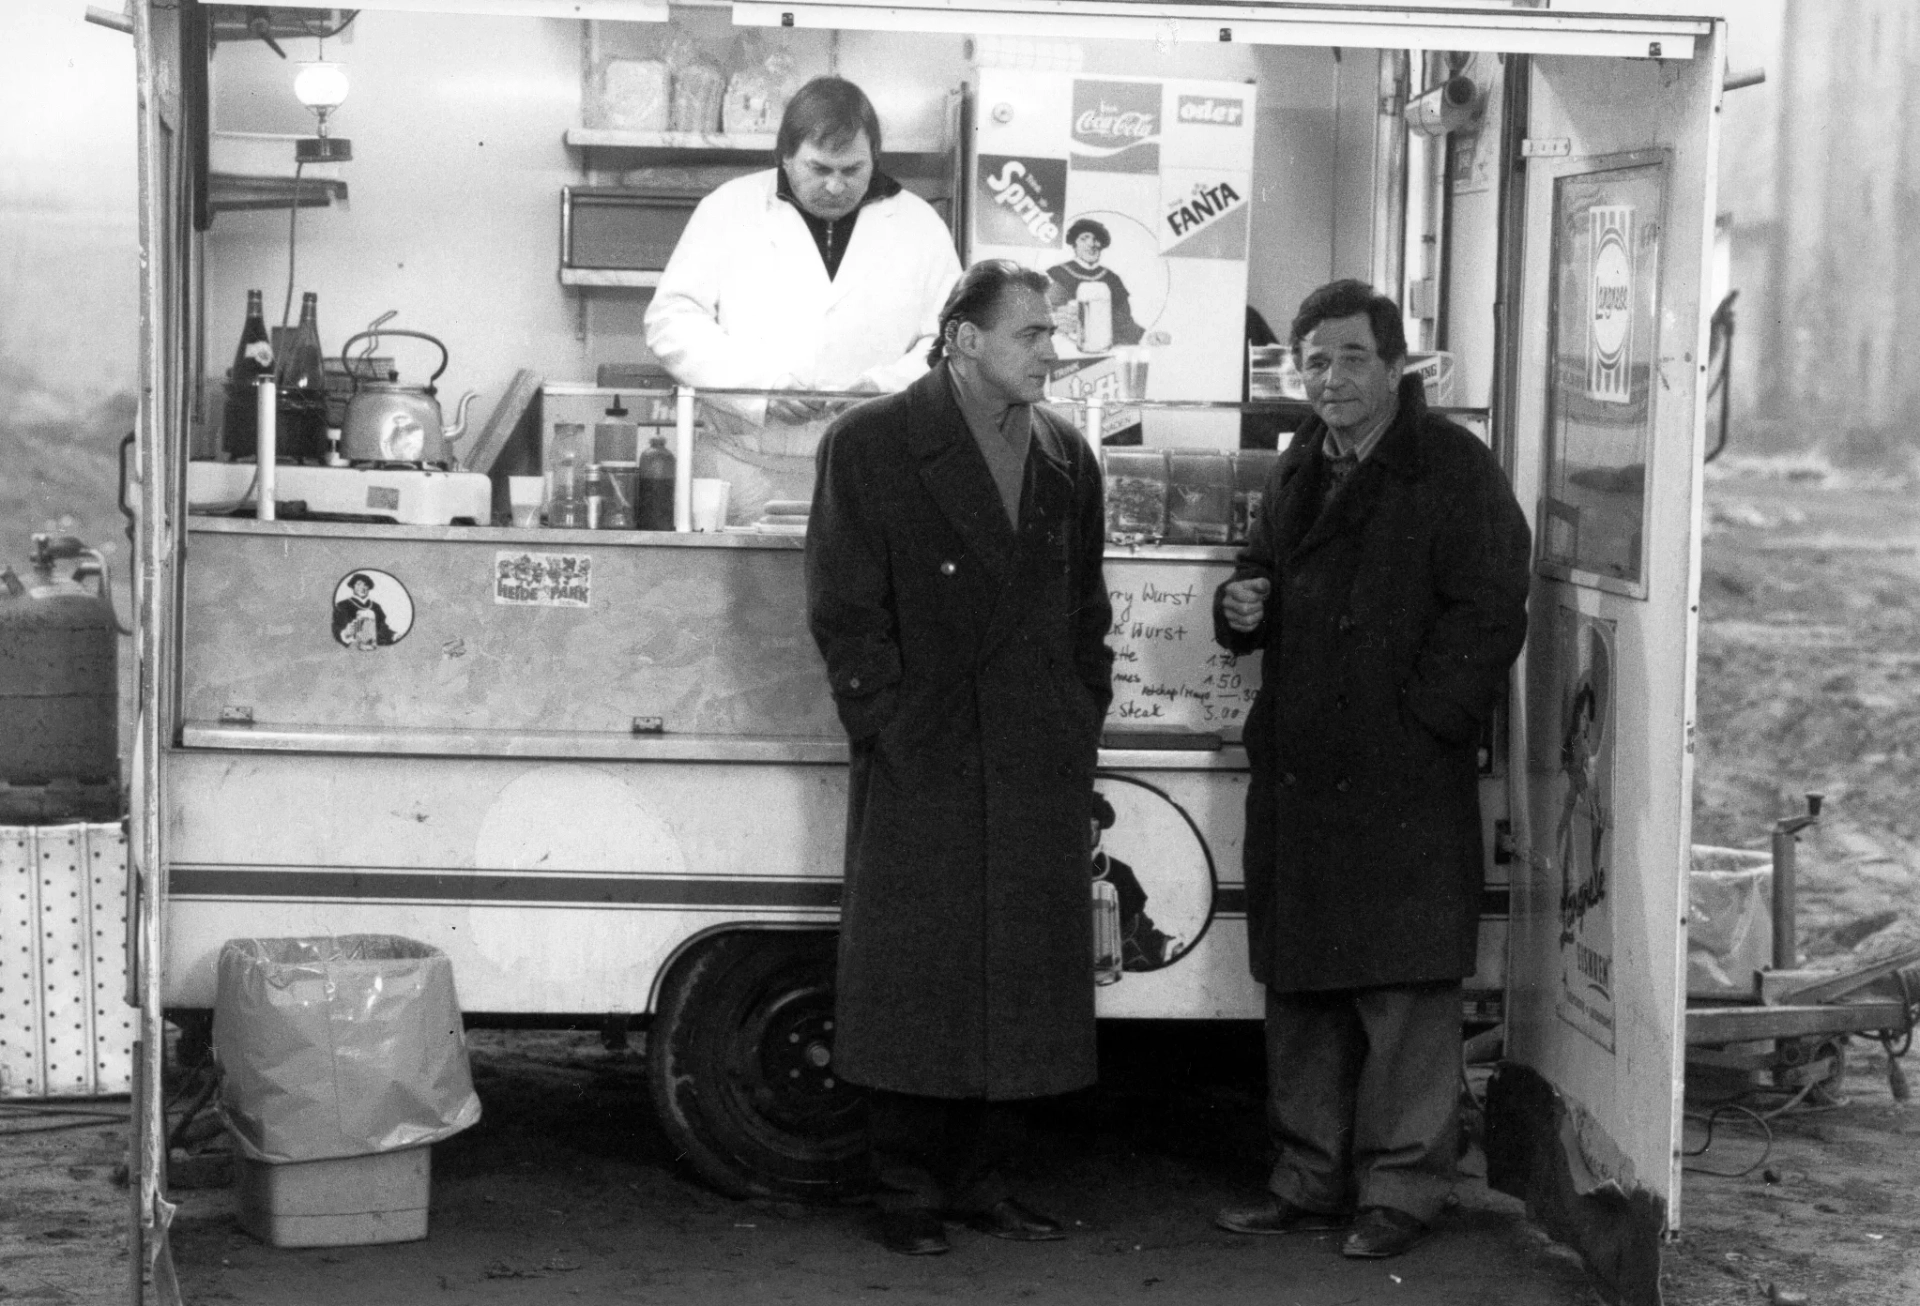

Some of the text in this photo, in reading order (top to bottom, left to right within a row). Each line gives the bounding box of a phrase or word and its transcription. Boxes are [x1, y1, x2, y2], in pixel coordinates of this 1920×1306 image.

[986, 161, 1059, 243] Sprite
[1167, 182, 1240, 236] FANTA
[497, 579, 590, 603] HEIDE PARK
[1142, 583, 1197, 606] Wurst
[1131, 622, 1188, 642] Wurst
[1203, 674, 1242, 690] 1.50
[1119, 700, 1166, 719] Steak
